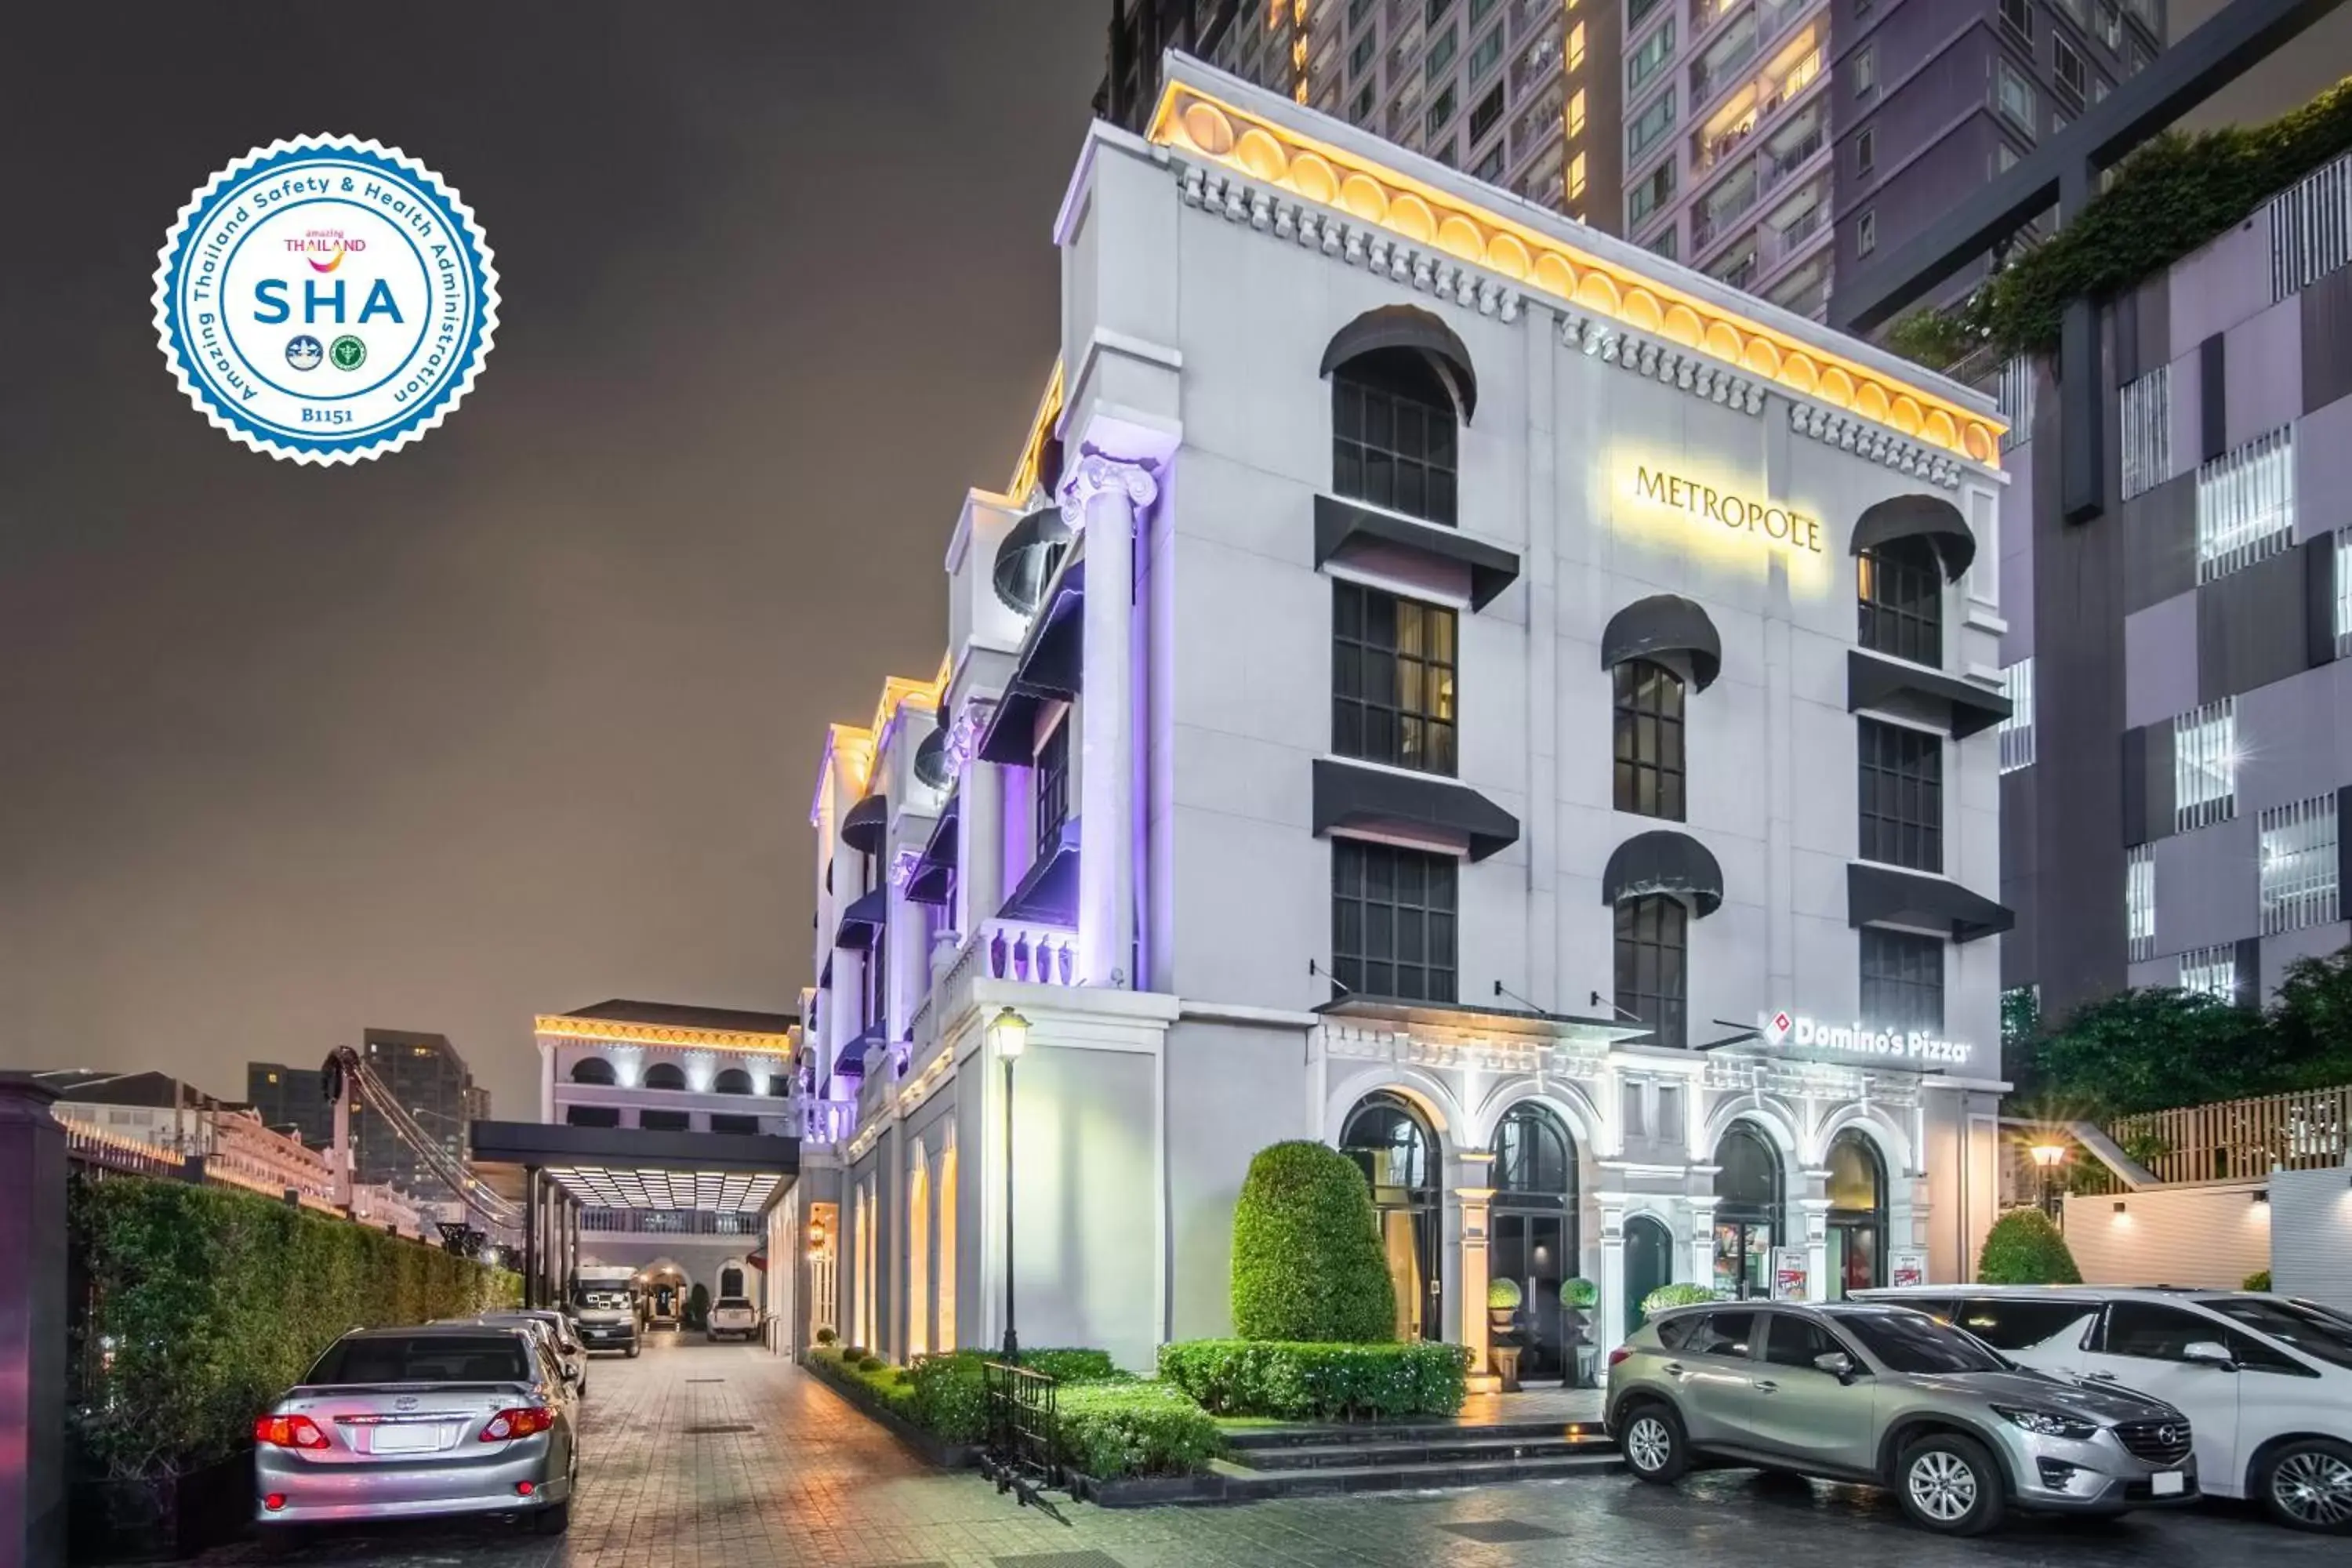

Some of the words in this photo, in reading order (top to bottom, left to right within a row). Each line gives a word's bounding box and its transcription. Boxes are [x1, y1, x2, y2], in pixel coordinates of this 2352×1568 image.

[1635, 466, 1821, 553] METROPOLE
[1794, 1017, 1904, 1056] Domino's
[1907, 1029, 1968, 1061] Pizza
